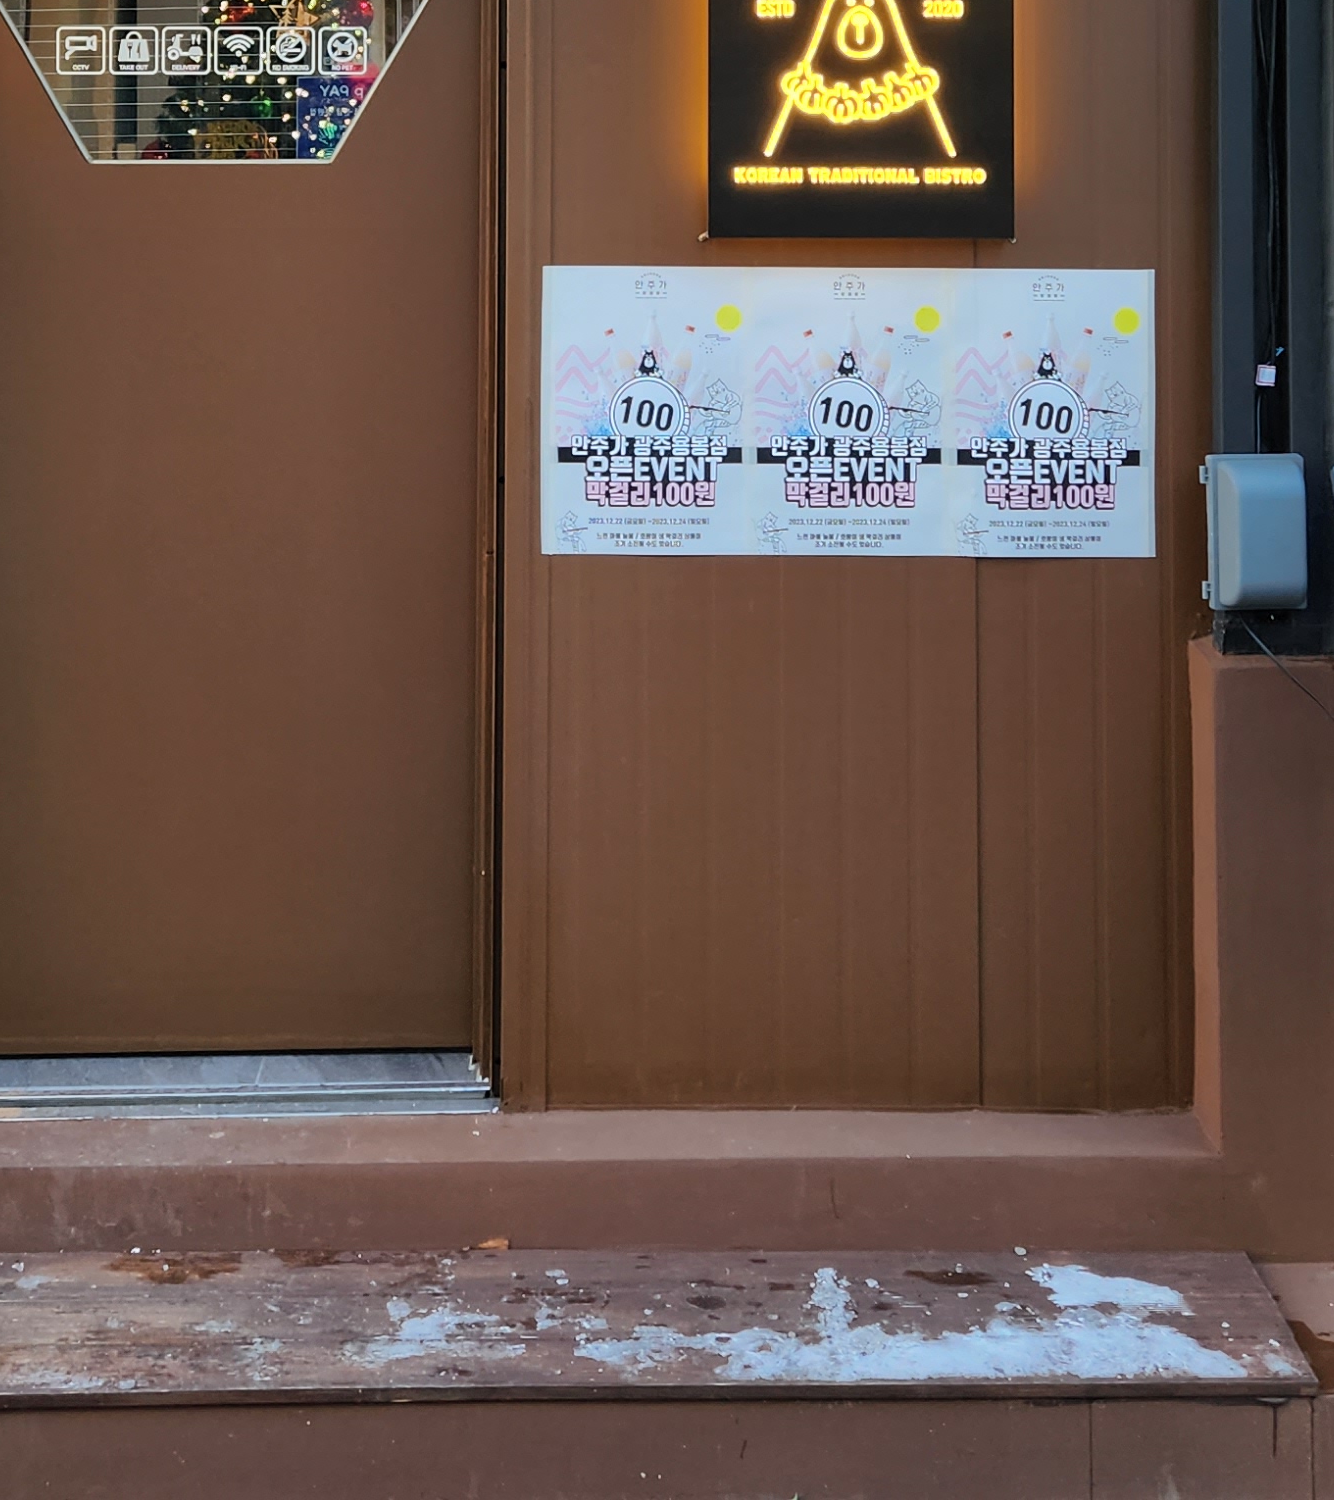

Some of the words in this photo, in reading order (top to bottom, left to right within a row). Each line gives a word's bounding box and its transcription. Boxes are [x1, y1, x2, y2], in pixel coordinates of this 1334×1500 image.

[733, 166, 804, 184] KOREAN
[808, 167, 919, 185] TRADITIONAL
[924, 168, 987, 185] BISTRO
[619, 395, 674, 431] 100
[818, 396, 874, 432] 100
[1018, 399, 1073, 435] 100
[571, 435, 629, 456] 안주가
[633, 435, 728, 457] 광주용봉점
[770, 435, 829, 457] 안주가
[832, 435, 928, 458] 광주용봉점
[970, 437, 1029, 458] 안주가
[1032, 437, 1128, 459] 광주용봉점
[585, 456, 722, 482] 오픈EVENT
[784, 456, 922, 483] 오픈EVENT
[984, 458, 1122, 484] 오픈EVENT
[586, 481, 716, 506] 막걸리100원
[785, 481, 916, 507] 막걸리100원
[985, 483, 1116, 508] 막걸리100원
